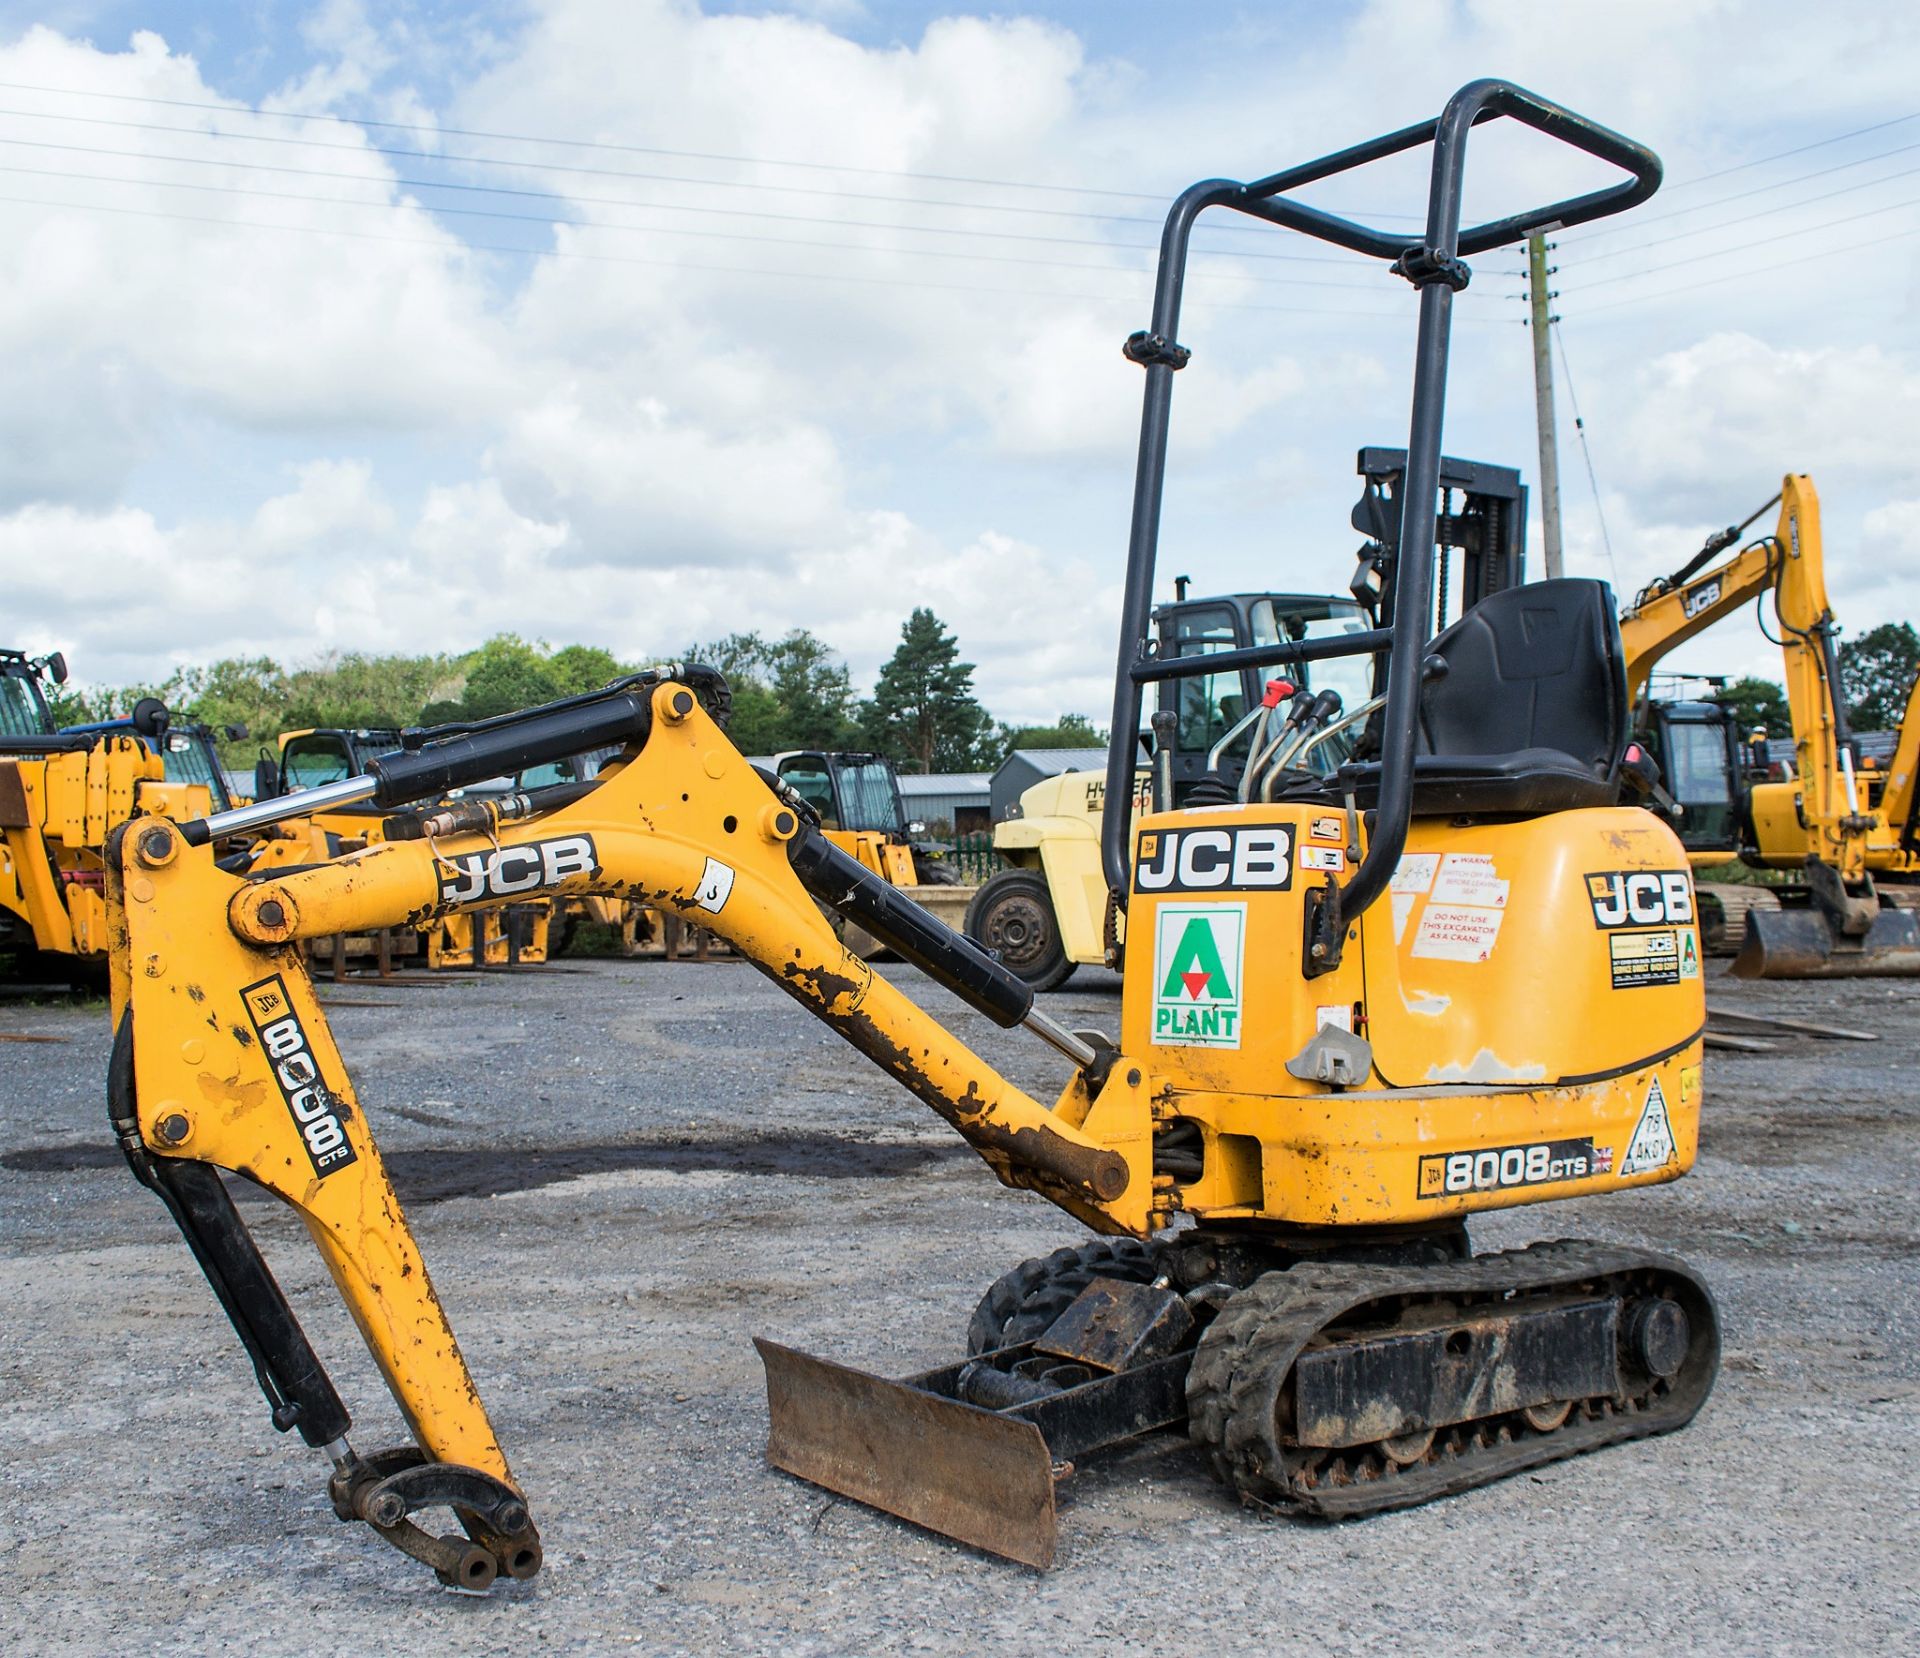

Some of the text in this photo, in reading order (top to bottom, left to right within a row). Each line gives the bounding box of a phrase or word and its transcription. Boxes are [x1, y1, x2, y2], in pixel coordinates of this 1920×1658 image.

[1685, 583, 1720, 618] JCB
[1086, 777, 1152, 799] HYER
[443, 838, 595, 903] JCB
[1138, 829, 1290, 888] JCB
[1595, 874, 1693, 925] JCB
[1423, 922, 1495, 934] THIS EXCAVATOR
[1450, 914, 1468, 922] NOT
[1450, 934, 1480, 943] CRANE
[1648, 937, 1673, 952] JCB
[1162, 918, 1233, 998] A
[257, 994, 280, 1012] JCB
[1156, 1009, 1237, 1037] PLANT
